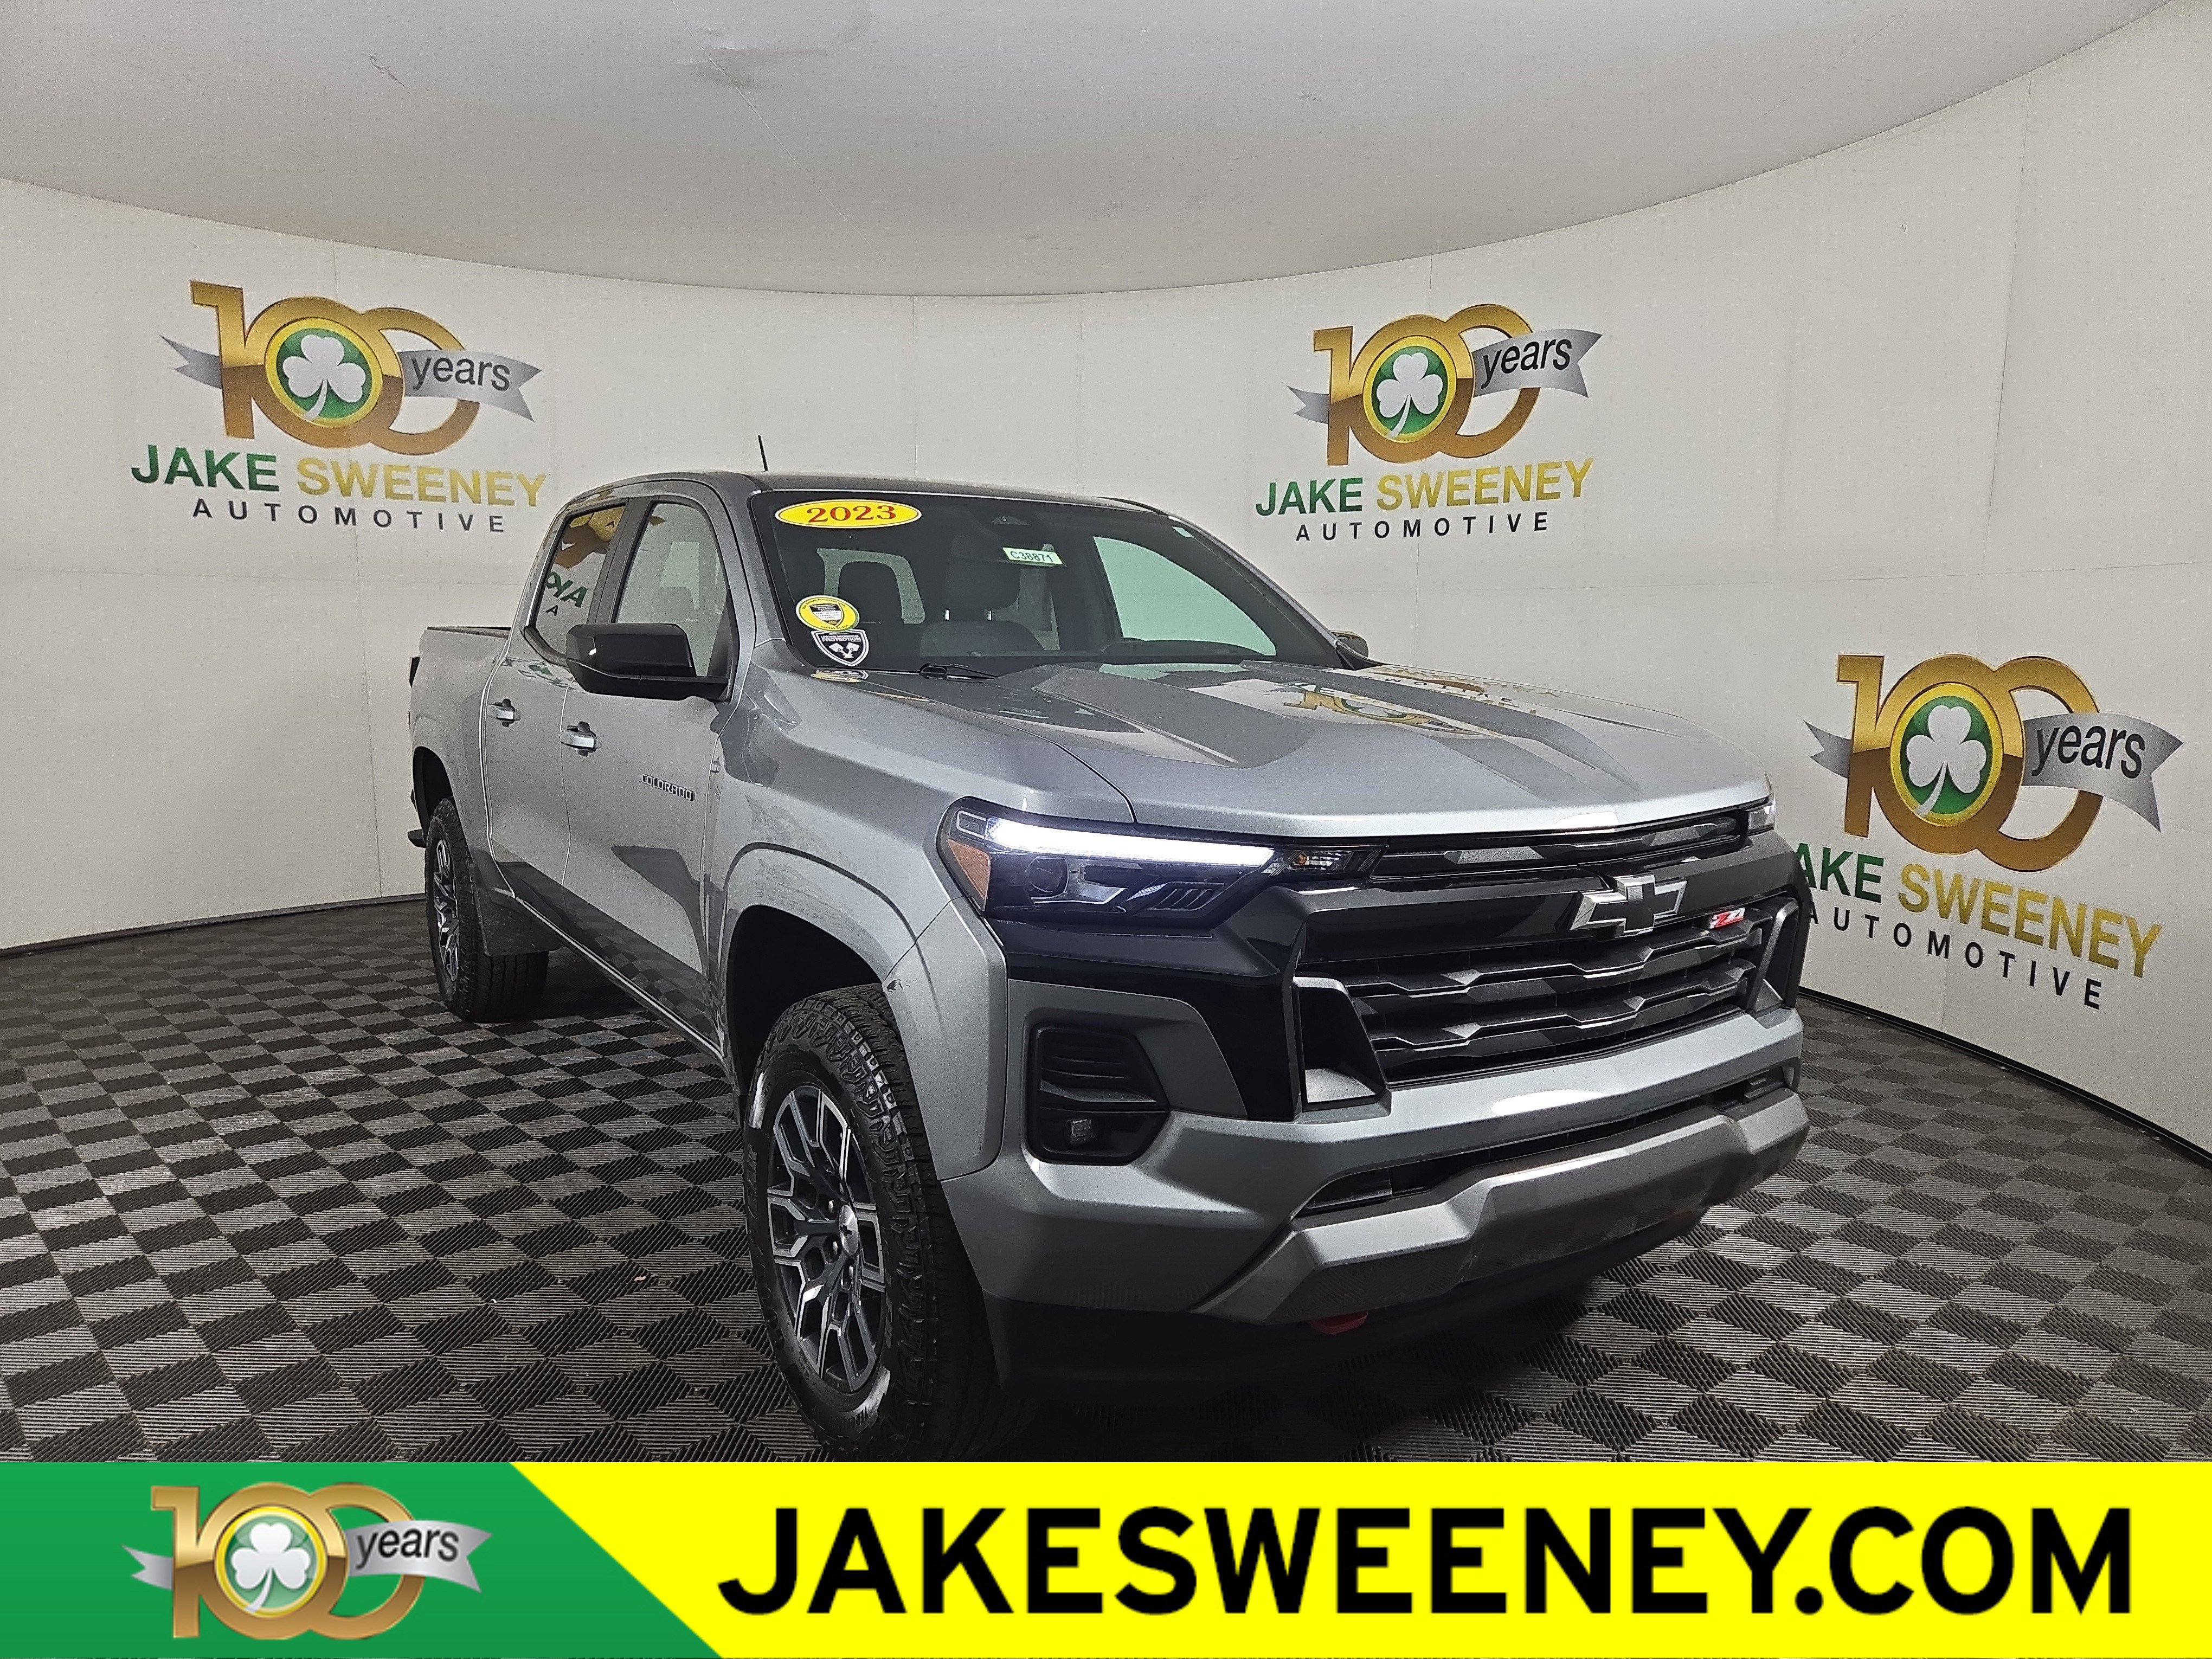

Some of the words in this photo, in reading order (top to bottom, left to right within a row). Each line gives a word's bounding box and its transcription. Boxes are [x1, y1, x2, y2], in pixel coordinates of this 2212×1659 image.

[190, 280, 480, 456] 100
[410, 353, 511, 391] years
[1313, 304, 1541, 466] 100
[1481, 338, 1571, 389] years
[131, 445, 280, 492] JAKE
[297, 458, 548, 508] SWEENEY
[1256, 477, 1364, 516] JAKE
[1377, 458, 1594, 511] SWEENEY
[192, 498, 505, 533] AUTOMOTIVE
[807, 505, 897, 523] 2023
[1295, 511, 1548, 542] AUTOMOTIVE
[1010, 551, 1053, 562] C38871
[1837, 653, 2104, 873] 100
[2031, 723, 2145, 779] years
[641, 774, 696, 801] COLORADO
[1898, 863, 2163, 979] SWEENEY
